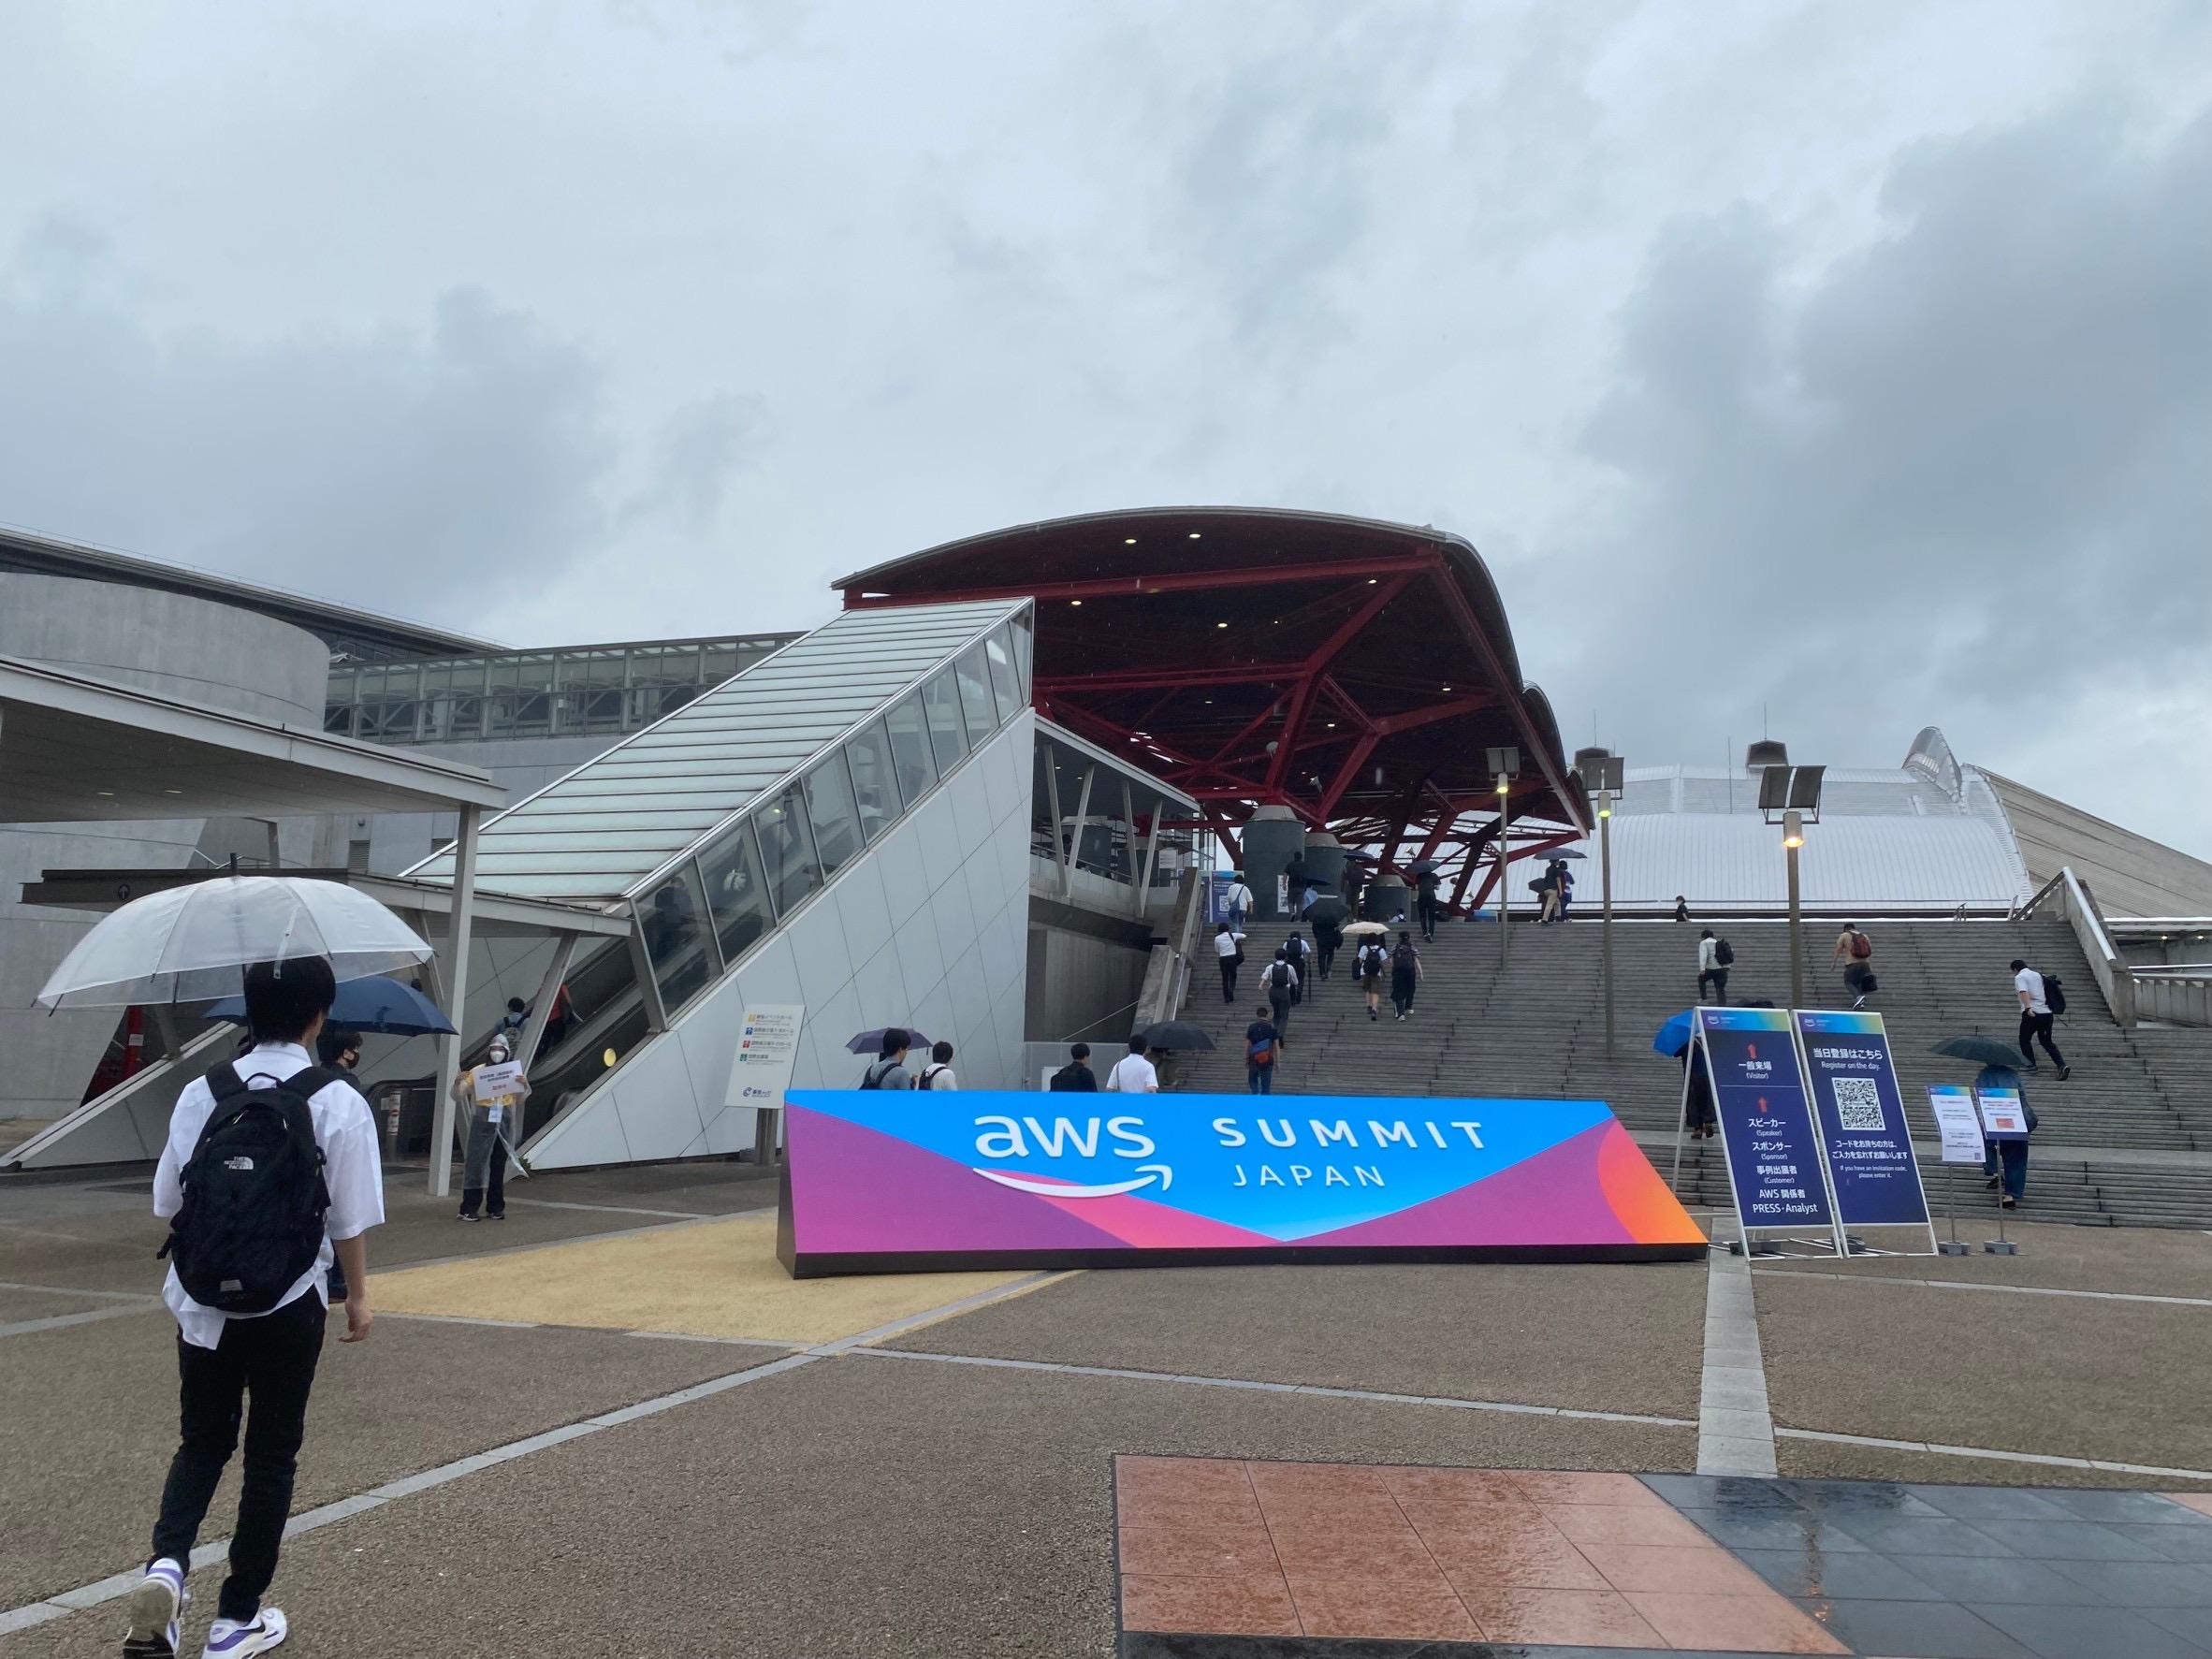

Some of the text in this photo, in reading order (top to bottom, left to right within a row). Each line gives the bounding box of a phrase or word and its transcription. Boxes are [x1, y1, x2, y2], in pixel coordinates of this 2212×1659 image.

[1813, 1048, 1883, 1059] 当日登録はこちら
[1739, 1061, 1772, 1070] 一般来場
[1821, 1061, 1846, 1070] Register
[1748, 1118, 1786, 1127] スピーカー
[974, 1115, 1156, 1158] aws
[1213, 1117, 1485, 1149] SUMMIT
[1752, 1142, 1792, 1151] スポンサー
[1233, 1164, 1386, 1186] JAPAN
[1759, 1189, 1779, 1198] AWS
